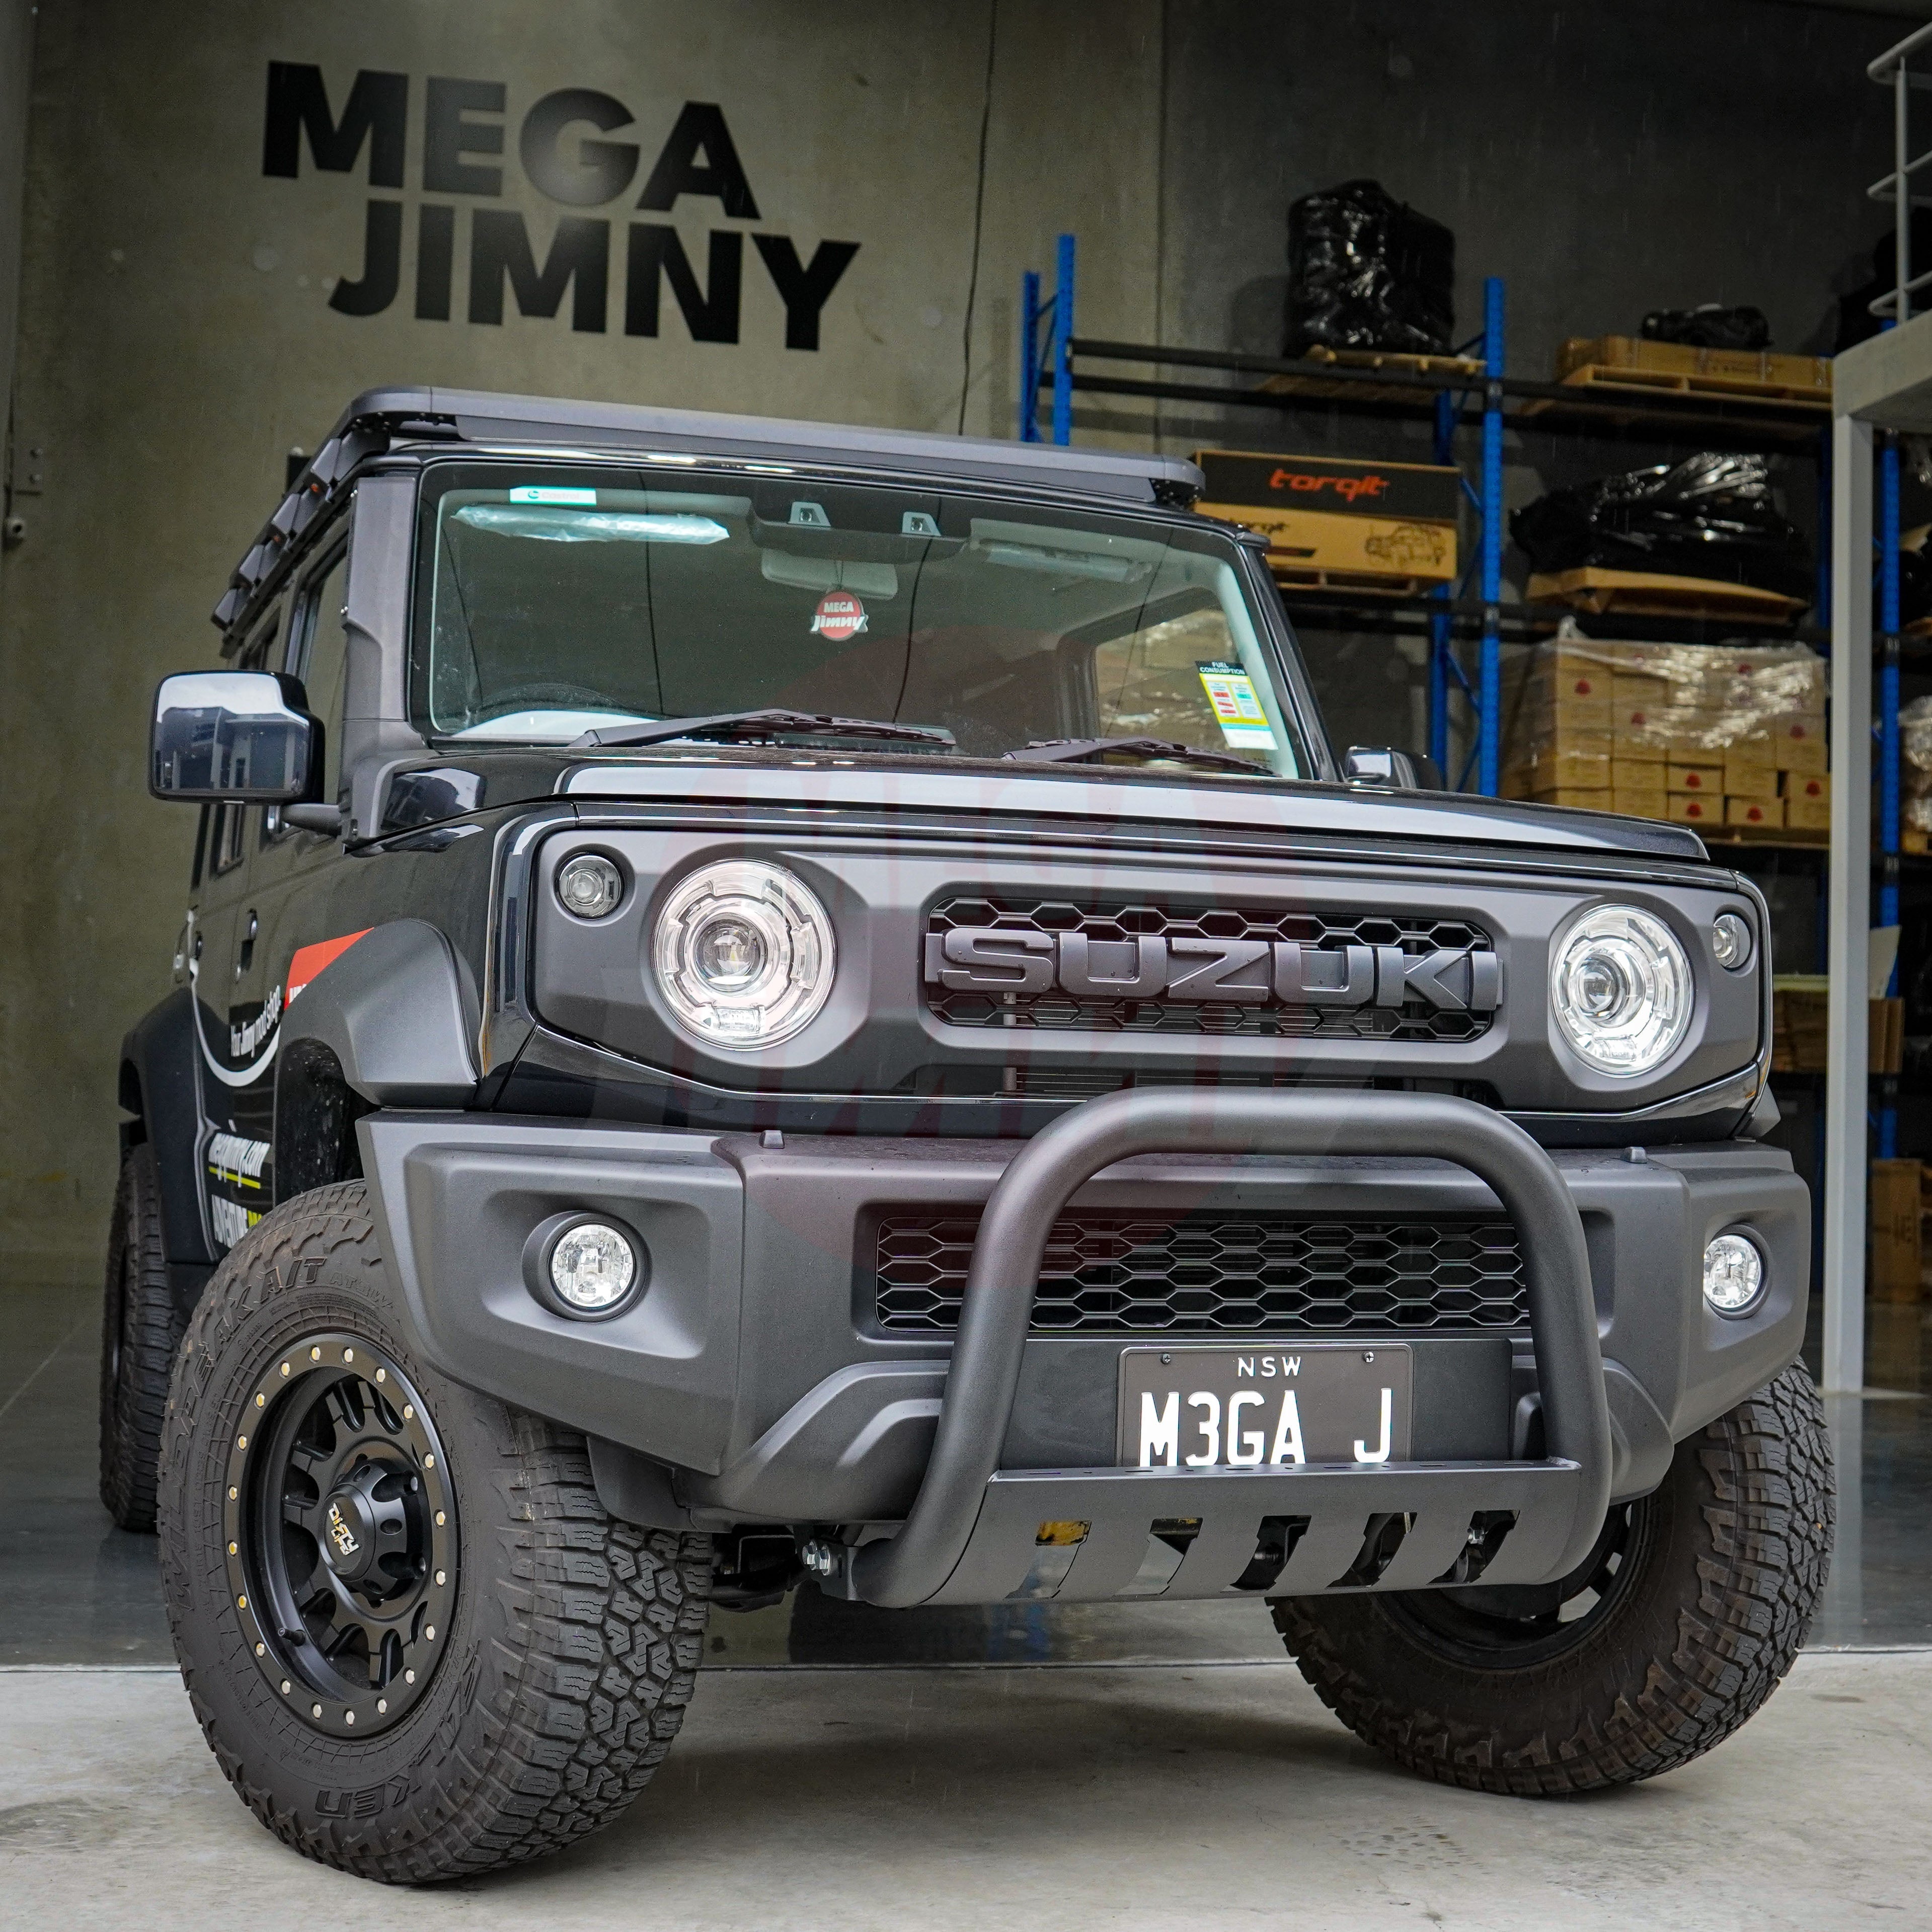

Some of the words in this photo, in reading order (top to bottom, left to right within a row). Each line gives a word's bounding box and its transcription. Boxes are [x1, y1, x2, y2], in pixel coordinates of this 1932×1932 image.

[262, 59, 762, 220] MEGA
[328, 198, 862, 352] JIMNY
[542, 491, 580, 500] Castrol
[824, 601, 854, 612] MEGA
[811, 615, 865, 632] Jimny
[1199, 667, 1246, 675] CONSUMPTION
[939, 926, 1498, 1011] SUZUKI
[1237, 1355, 1302, 1378] NSW
[1139, 1389, 1306, 1467] M3GA
[1353, 1387, 1393, 1464] J
